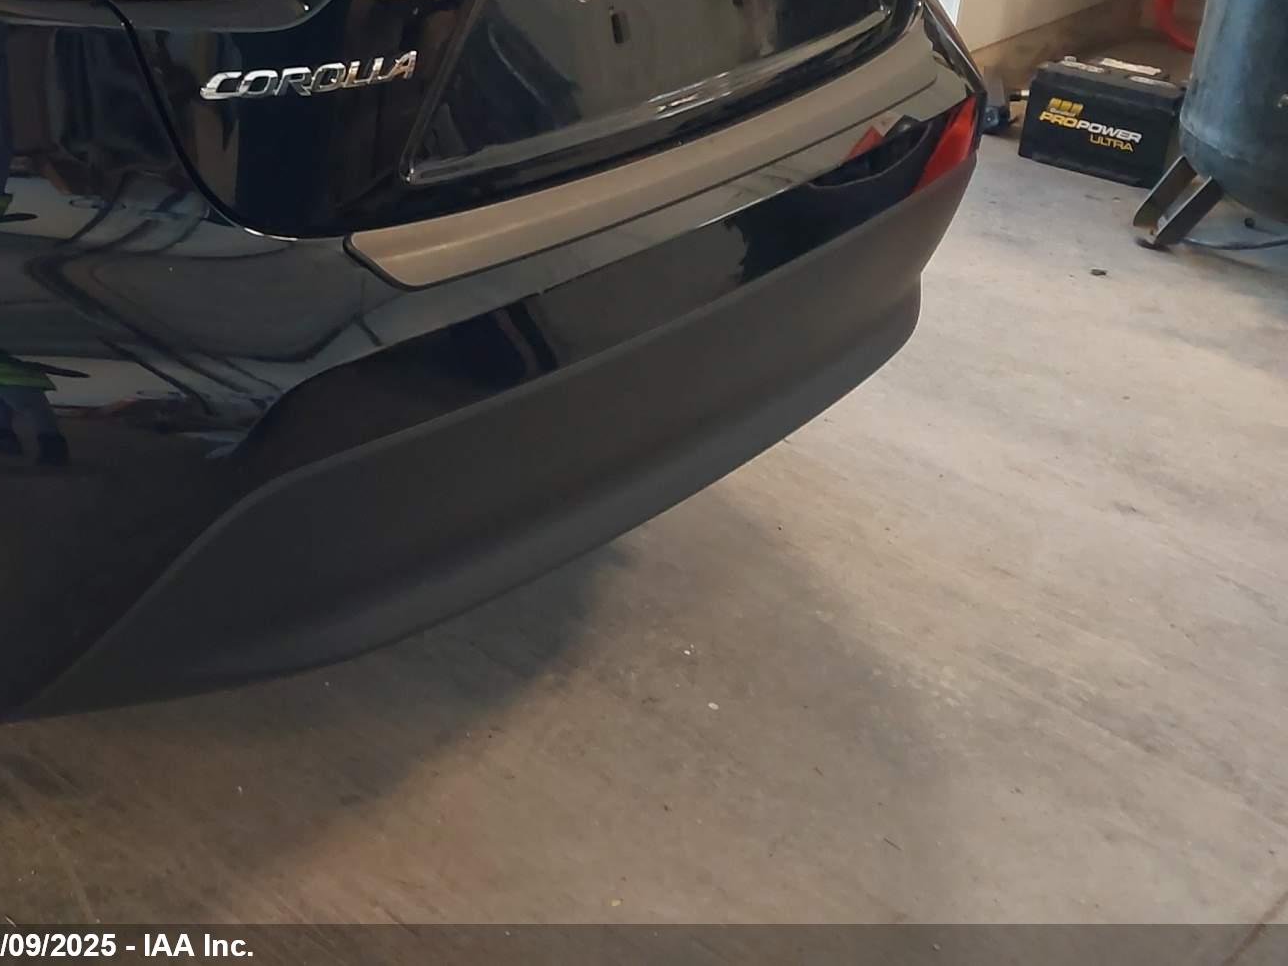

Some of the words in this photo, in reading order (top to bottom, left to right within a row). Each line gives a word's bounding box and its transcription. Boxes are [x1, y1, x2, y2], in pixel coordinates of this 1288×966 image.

[200, 50, 417, 100] COROLLA
[1039, 111, 1143, 144] PROPOWER
[1090, 134, 1134, 152] ULTRA
